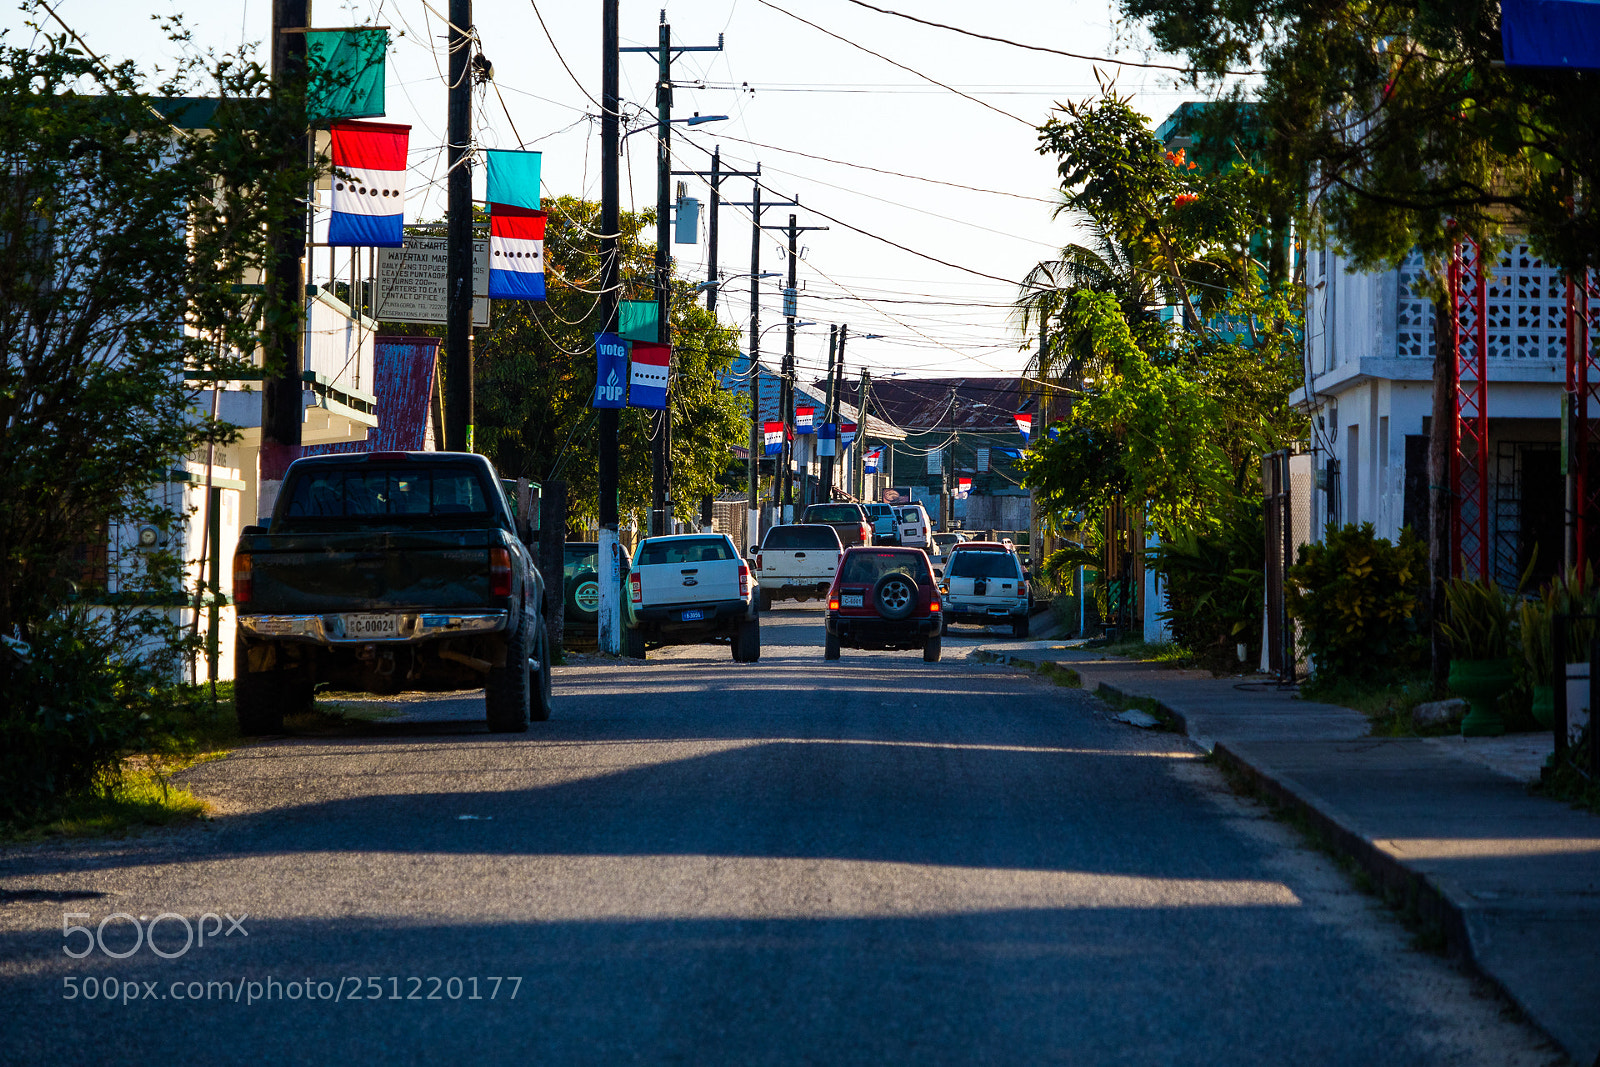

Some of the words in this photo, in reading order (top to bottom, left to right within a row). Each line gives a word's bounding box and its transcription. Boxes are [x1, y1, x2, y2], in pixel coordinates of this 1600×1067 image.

[419, 242, 448, 250] CHARTE
[381, 292, 412, 300] CONTACT
[414, 294, 437, 302] OFFICE
[599, 344, 625, 357] vote
[597, 386, 623, 401] PUP
[356, 620, 394, 632] C-00024
